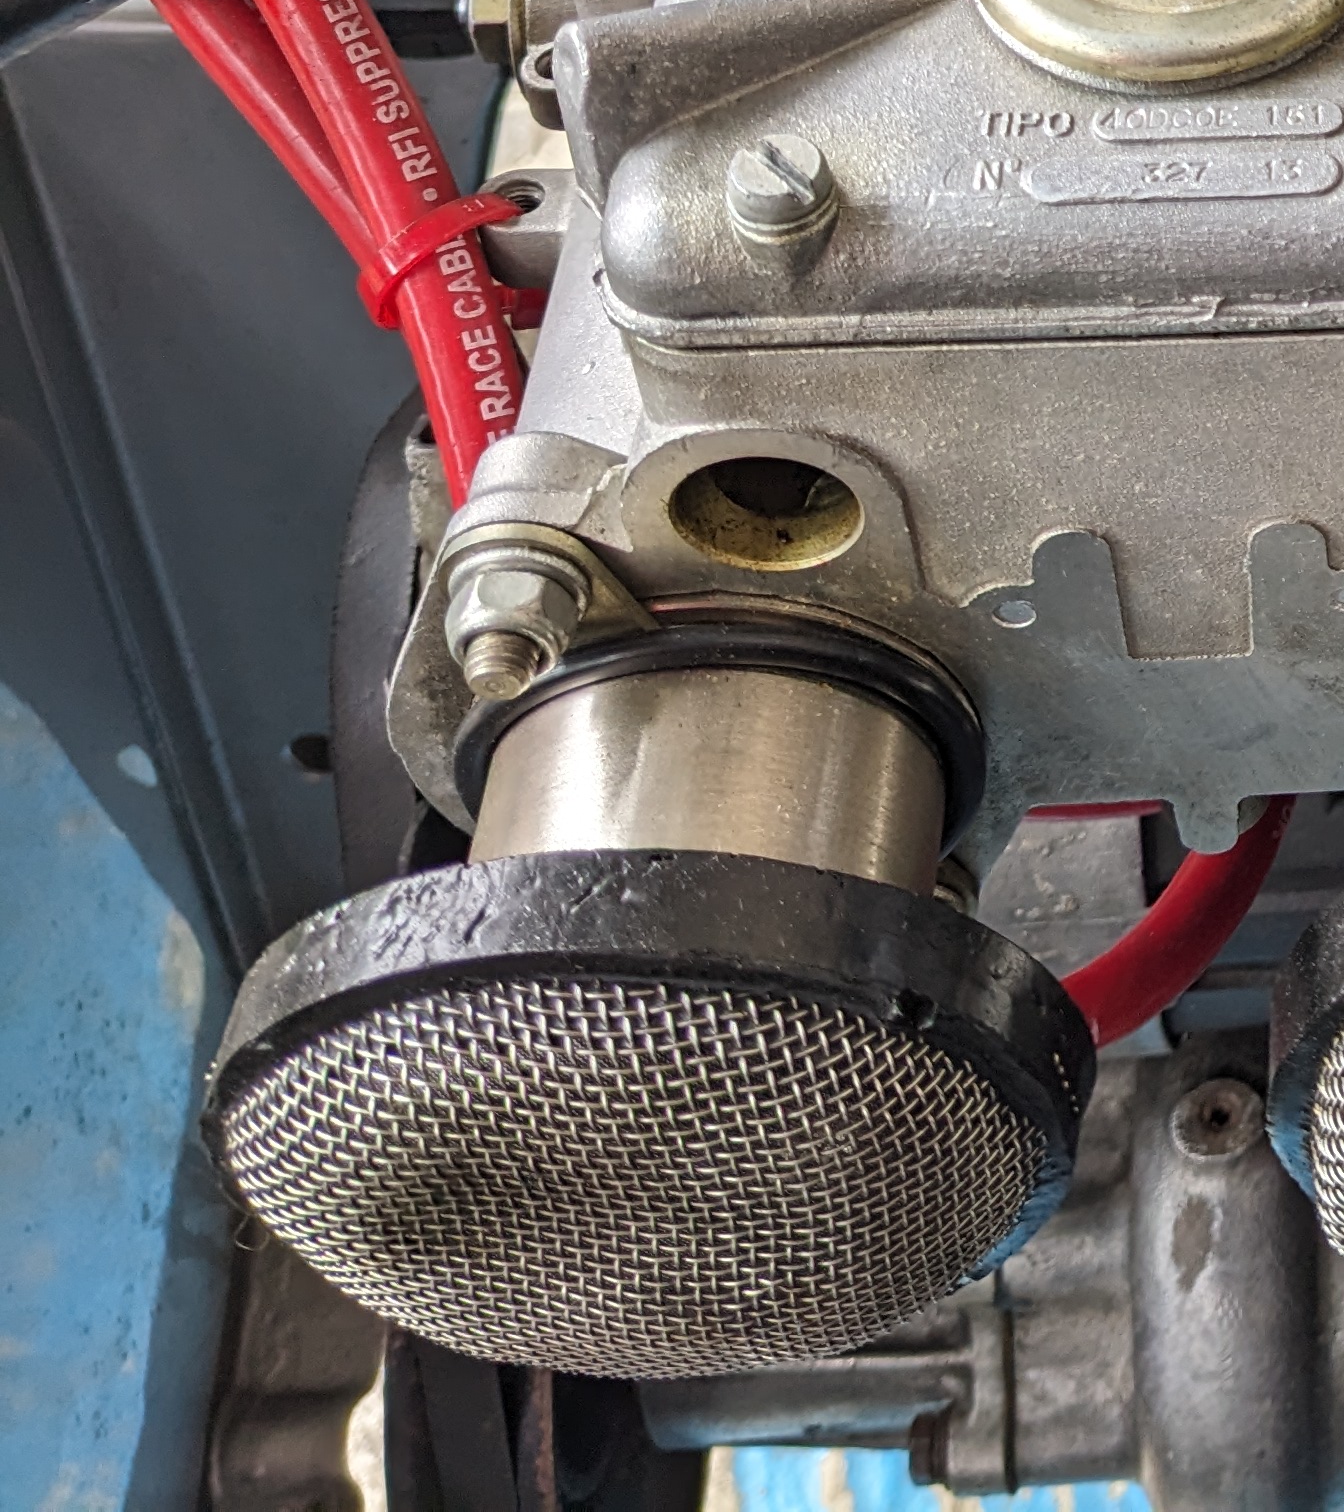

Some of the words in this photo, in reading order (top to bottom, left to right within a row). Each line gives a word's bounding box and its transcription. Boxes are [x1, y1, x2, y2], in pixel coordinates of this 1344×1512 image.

[980, 107, 1076, 140] TIPO
[387, 124, 440, 185] RFI
[462, 322, 518, 423] RACE
